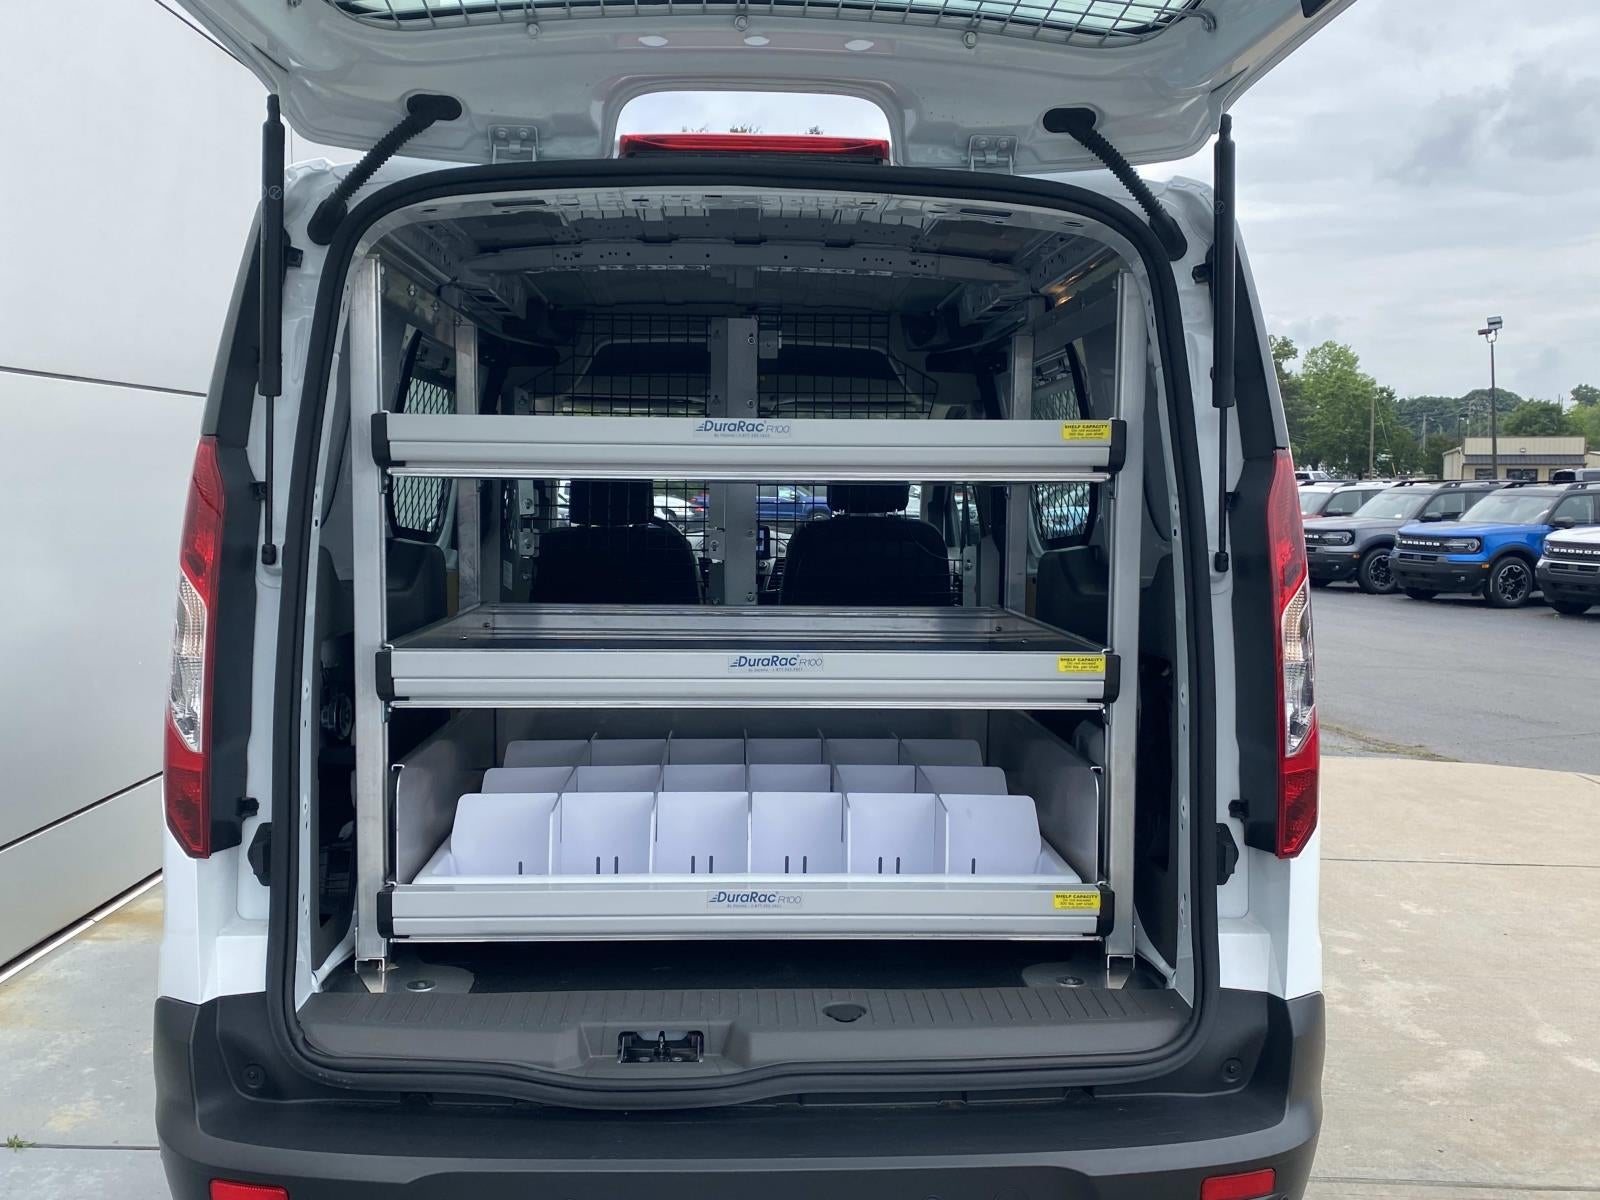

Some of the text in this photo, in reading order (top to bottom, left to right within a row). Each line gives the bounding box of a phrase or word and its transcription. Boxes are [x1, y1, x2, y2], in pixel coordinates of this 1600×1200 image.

[704, 420, 790, 434] DuraRac R100
[737, 655, 823, 667] DuraRac R100
[716, 891, 802, 904] DuraRac R100
